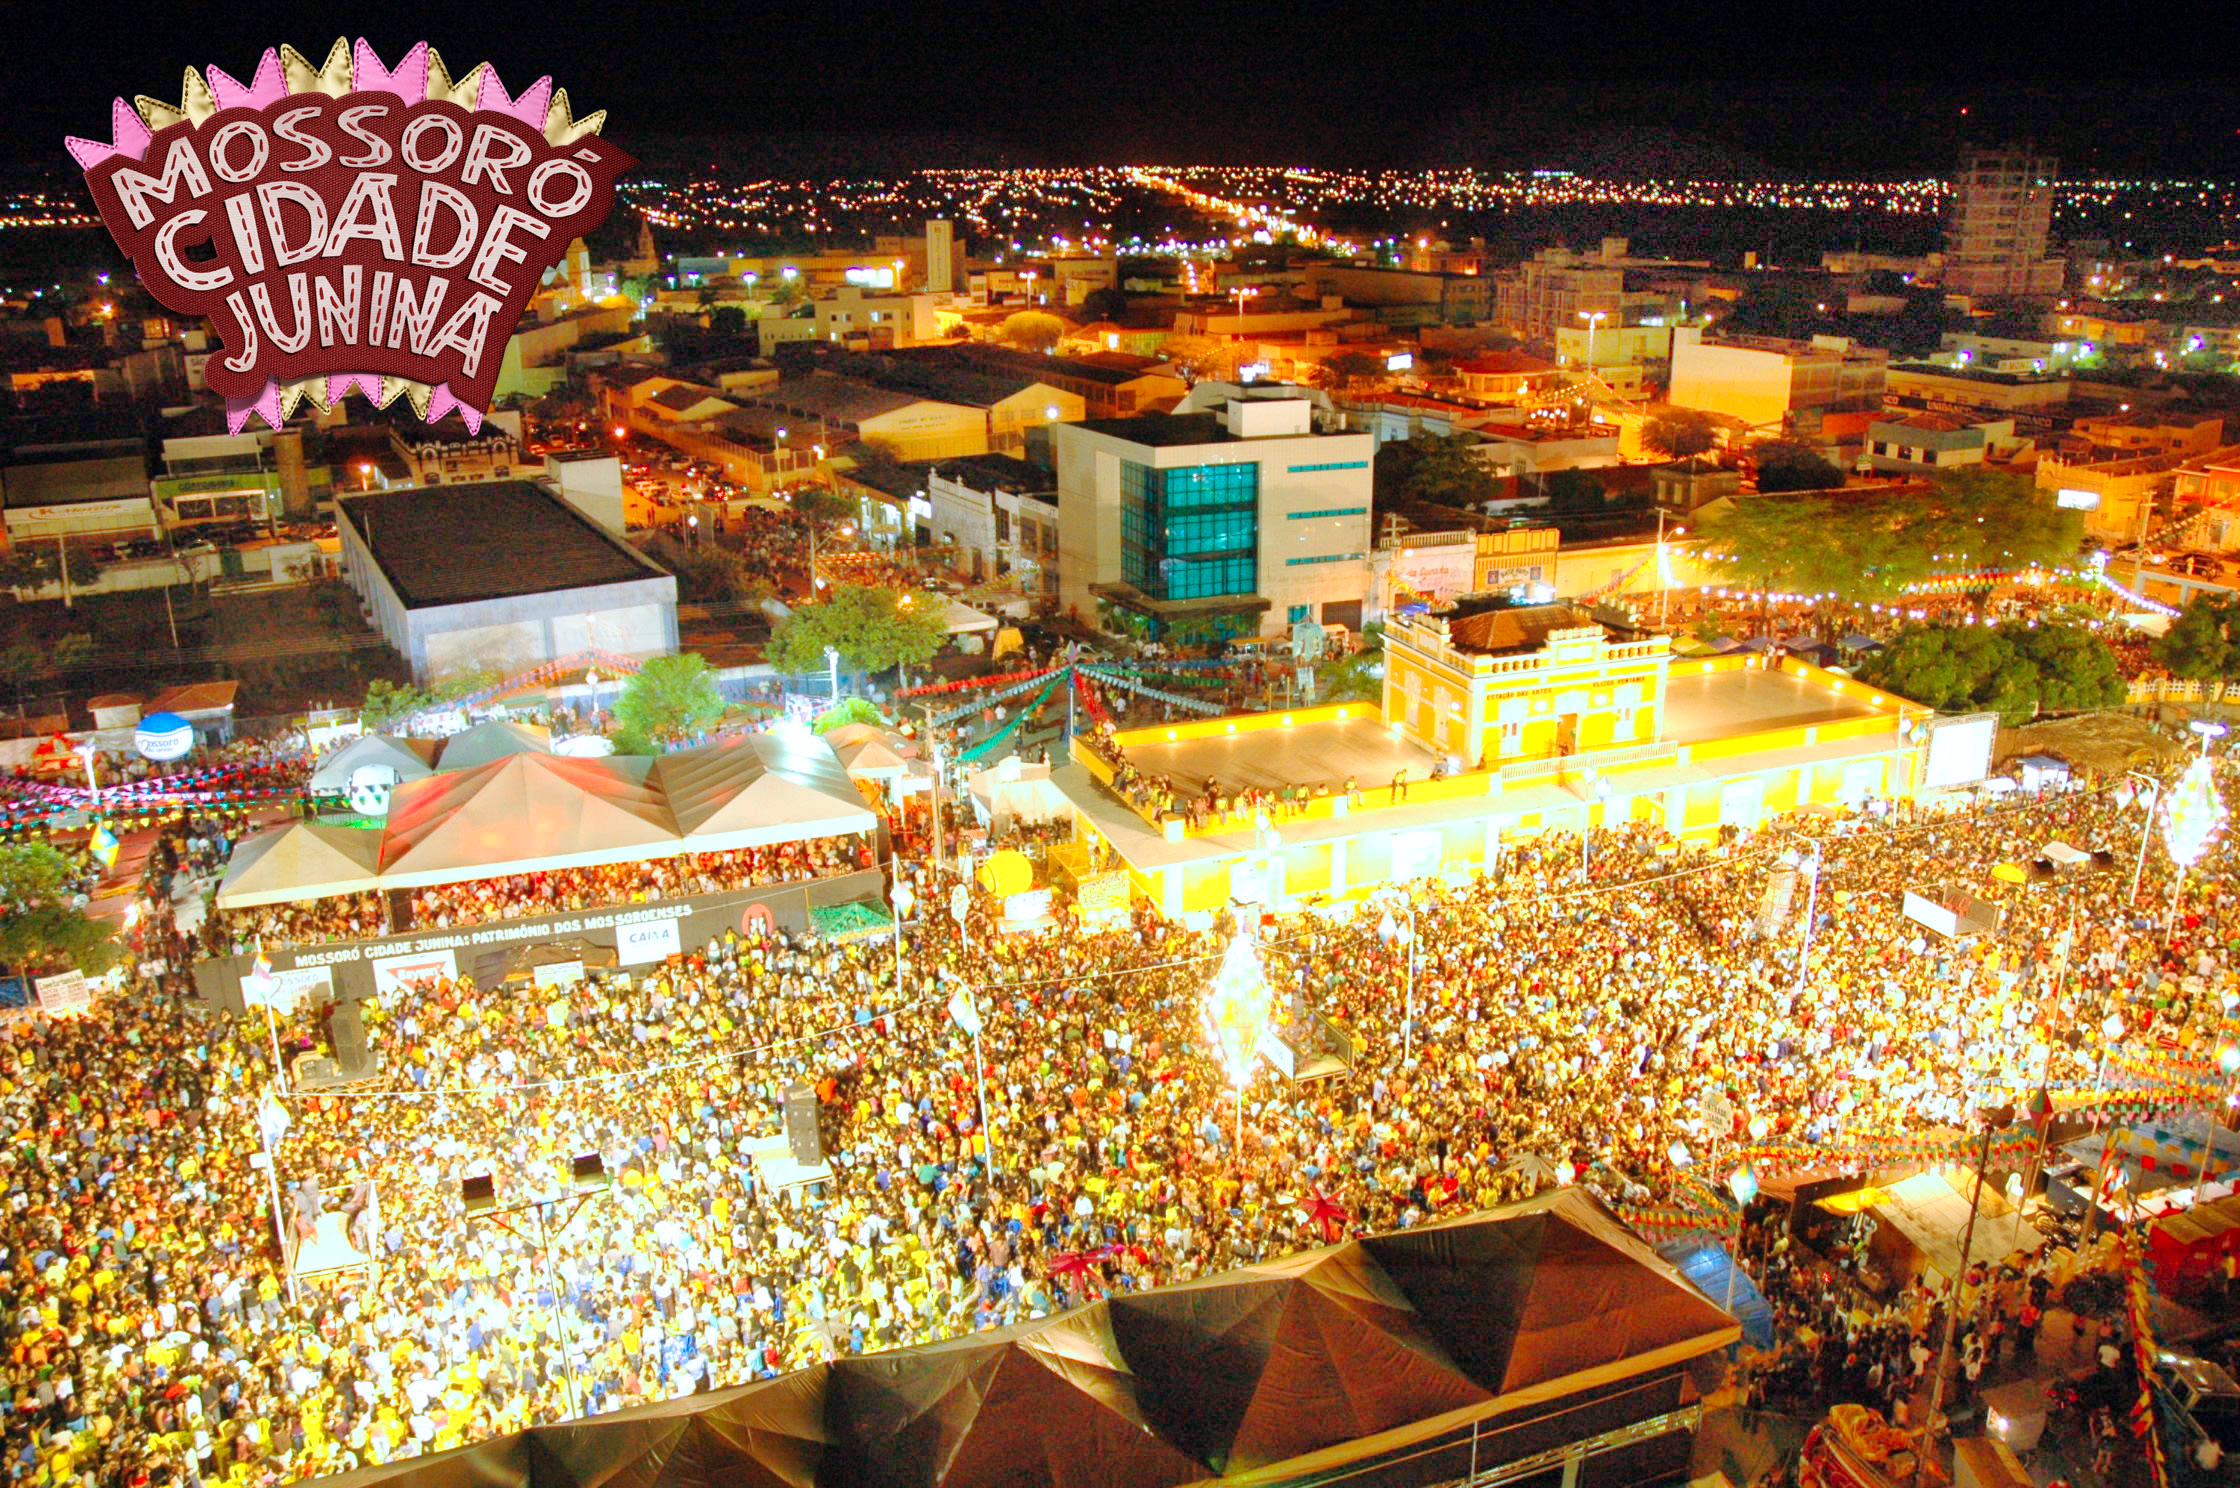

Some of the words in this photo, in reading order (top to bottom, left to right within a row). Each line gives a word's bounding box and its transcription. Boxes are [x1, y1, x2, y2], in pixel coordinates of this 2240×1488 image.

[294, 946, 361, 968] MOSSORÓ
[363, 941, 412, 959] CIDADE
[414, 932, 471, 952] JUNINA:
[472, 922, 550, 945] PATRIMÔNIO
[553, 919, 582, 934] DOS
[584, 904, 694, 930] MOSSOROENSES
[629, 928, 670, 944] CAIXA
